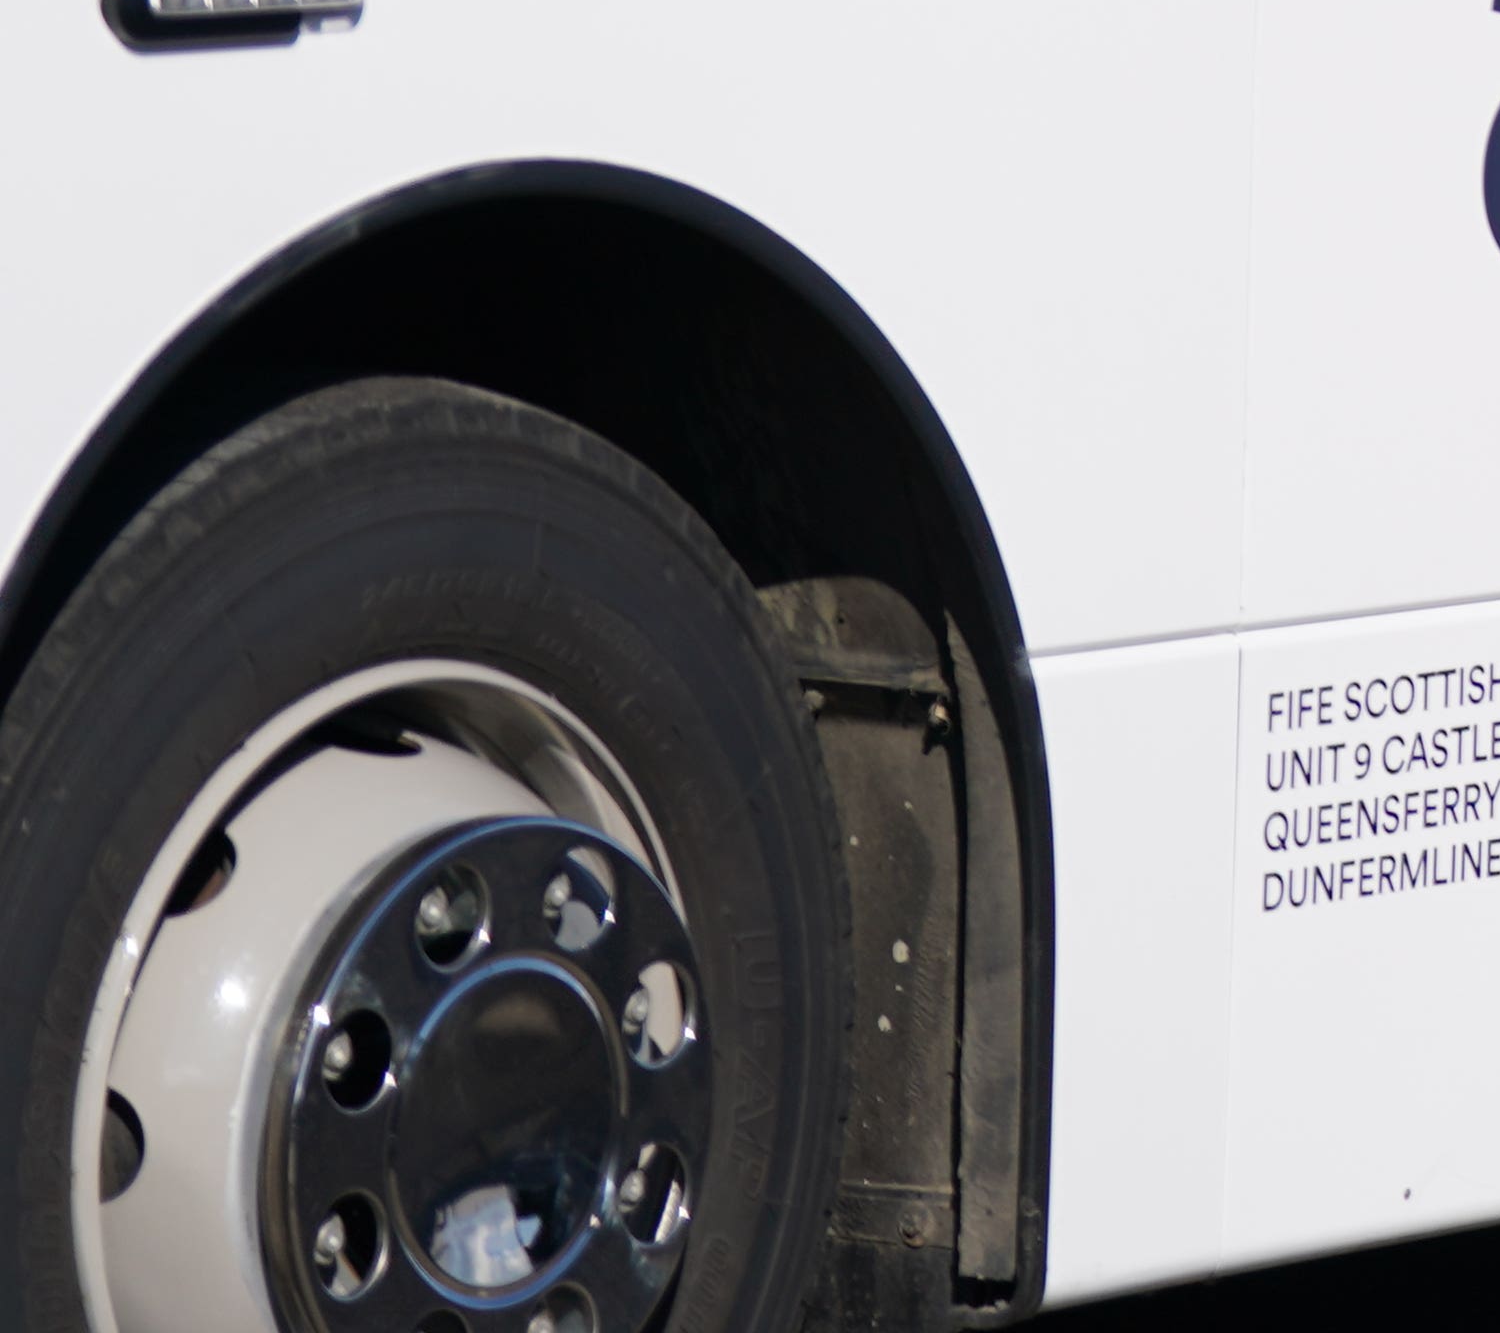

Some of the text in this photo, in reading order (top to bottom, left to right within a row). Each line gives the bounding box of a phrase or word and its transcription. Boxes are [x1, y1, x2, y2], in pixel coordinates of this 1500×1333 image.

[1267, 685, 1335, 733] FIFE
[1266, 743, 1347, 793] UNIT
[1354, 741, 1371, 781] 9
